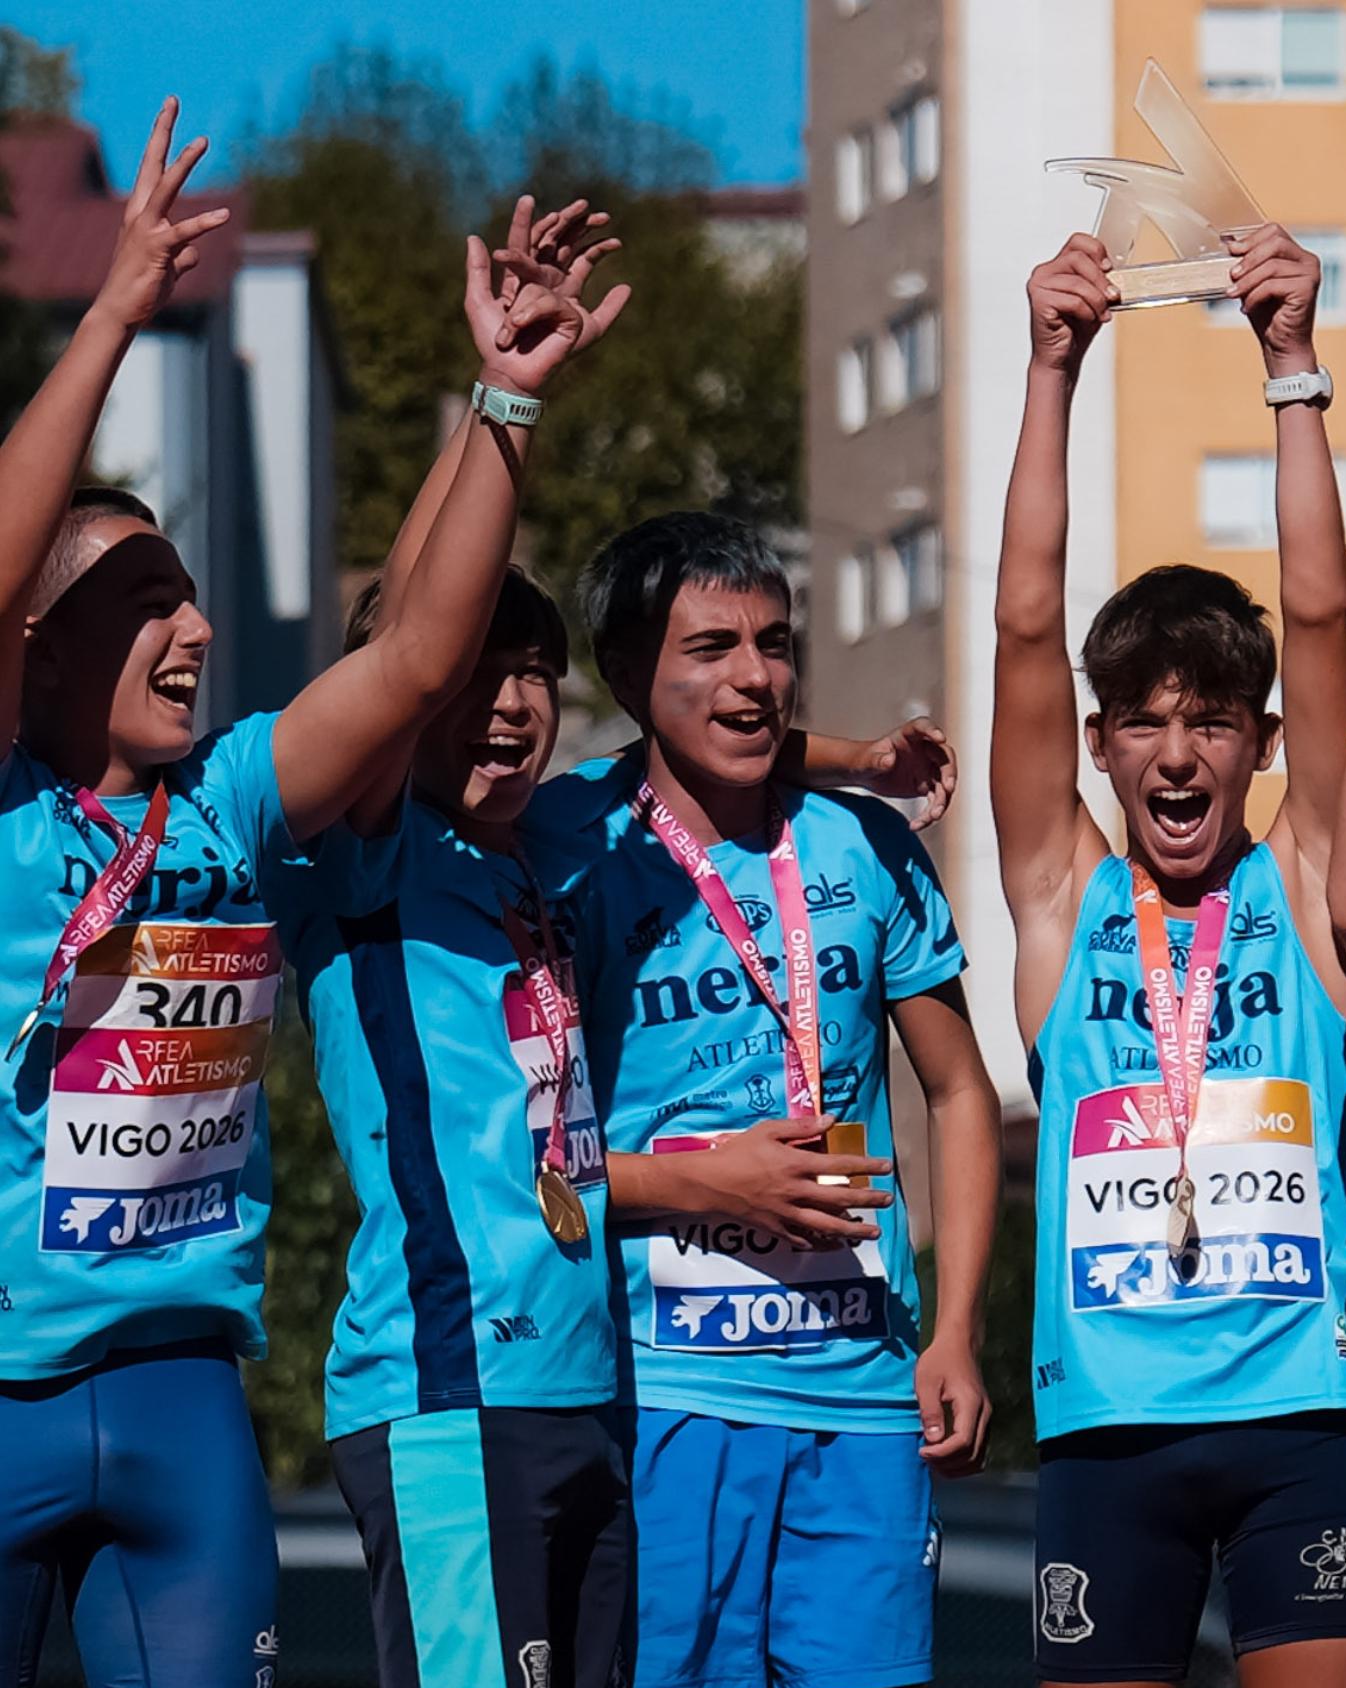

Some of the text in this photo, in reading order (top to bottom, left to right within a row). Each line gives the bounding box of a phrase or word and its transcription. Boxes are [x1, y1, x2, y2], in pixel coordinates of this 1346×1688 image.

[107, 834, 157, 910] ATLETISMO
[803, 873, 866, 905] als
[157, 930, 209, 951] RFEA
[163, 953, 268, 974] ATLETISMO
[790, 928, 814, 1031] ATLETISMO
[1150, 967, 1182, 1066] ATLETISMO
[1184, 966, 1213, 1067] ATLETISMO
[136, 1041, 194, 1063] RFEA
[145, 1056, 251, 1086] ATLETISMO
[67, 1111, 246, 1158] VIGO 2026
[1208, 1170, 1305, 1206] 2026
